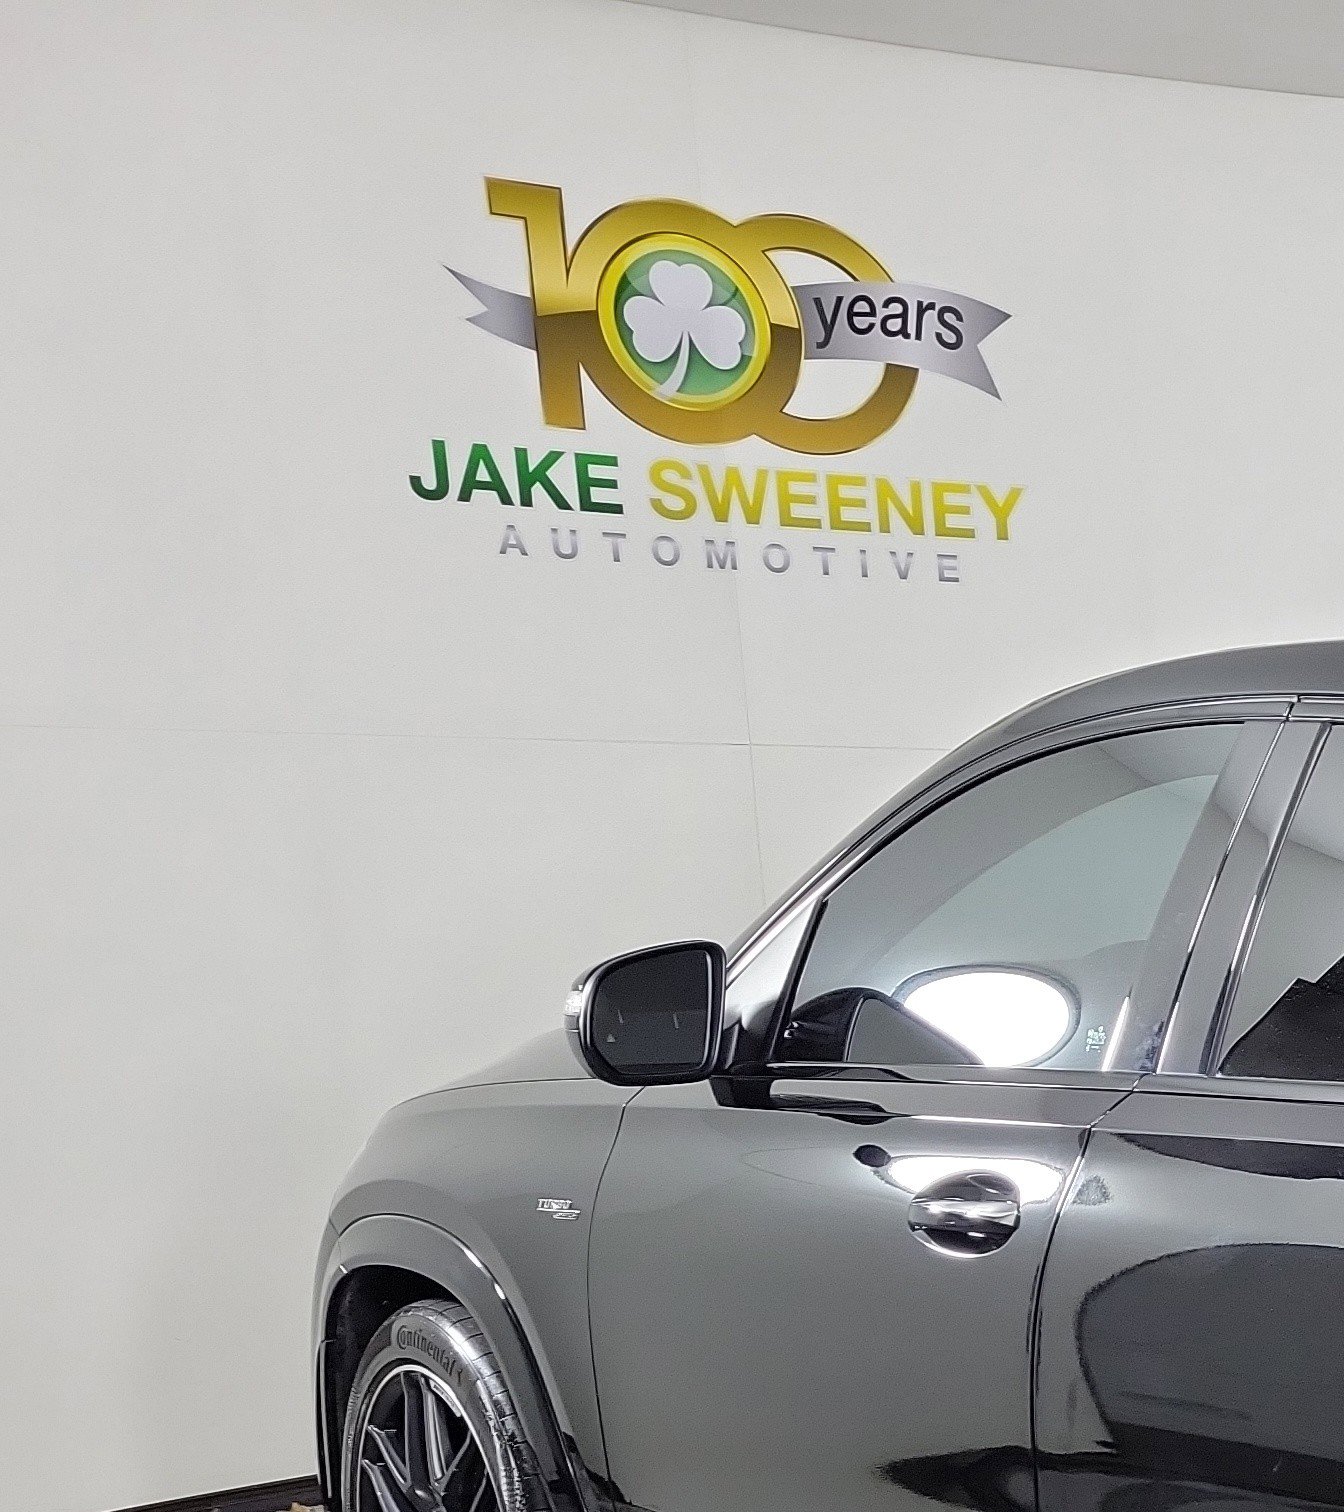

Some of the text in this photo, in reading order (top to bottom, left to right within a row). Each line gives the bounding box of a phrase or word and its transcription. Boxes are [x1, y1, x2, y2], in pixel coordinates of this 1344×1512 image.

[484, 175, 919, 455] 100
[812, 294, 965, 351] years
[408, 438, 1024, 542] JAKE SWEENEY
[498, 523, 961, 584] AUTOMOTIVE
